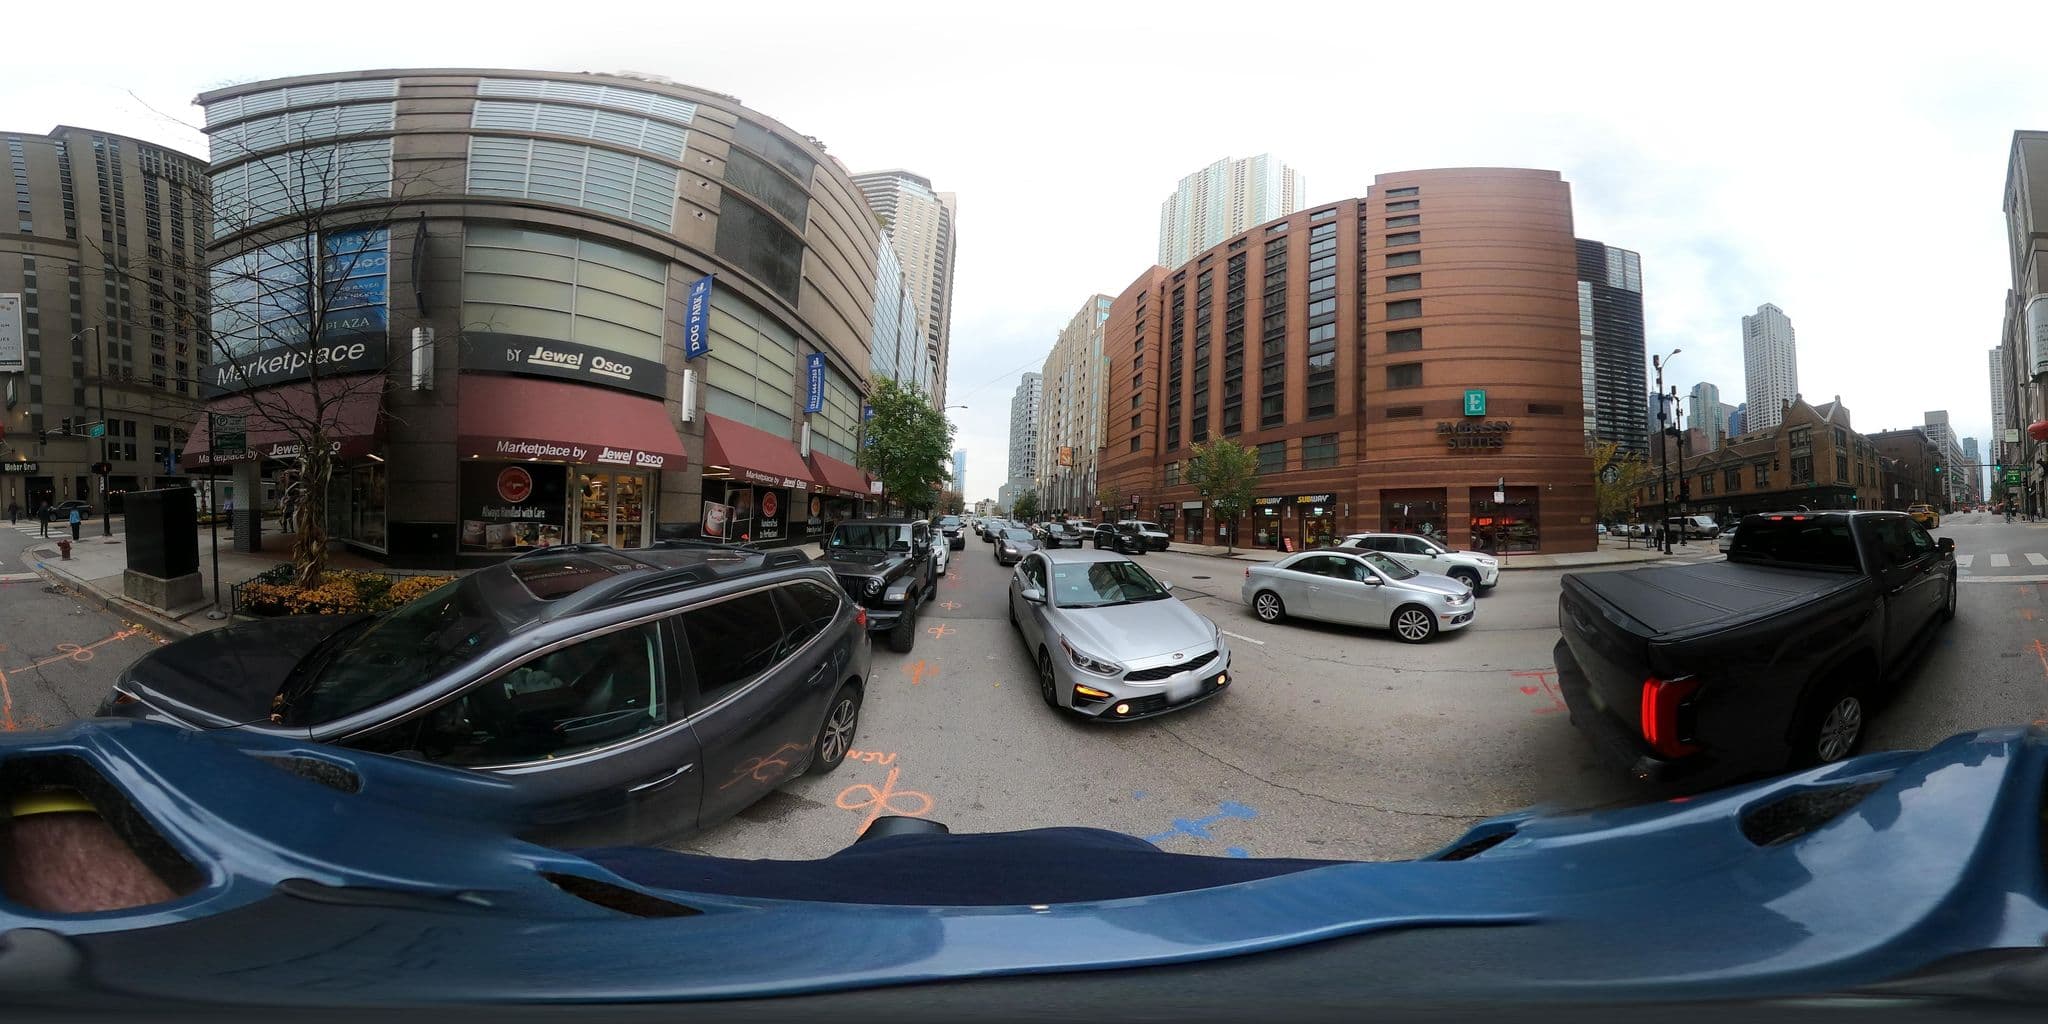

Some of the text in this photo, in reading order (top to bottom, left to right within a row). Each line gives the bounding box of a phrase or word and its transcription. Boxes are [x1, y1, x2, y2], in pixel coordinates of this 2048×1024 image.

[690, 295, 704, 352] DOG PARK
[216, 342, 366, 386] Marketplace
[506, 346, 633, 376] BY Jewel Osco
[1469, 393, 1482, 411] E
[1436, 421, 1513, 434] EMBASSY
[1447, 436, 1505, 449] SUITES
[496, 440, 664, 465] Marketplace by Jewel Osco
[745, 469, 773, 483] Marketplace
[773, 476, 780, 485] by
[1256, 497, 1282, 505] SUBWAY
[1297, 494, 1330, 504] SUBWAY
[521, 506, 534, 518] with
[534, 506, 546, 519] Care
